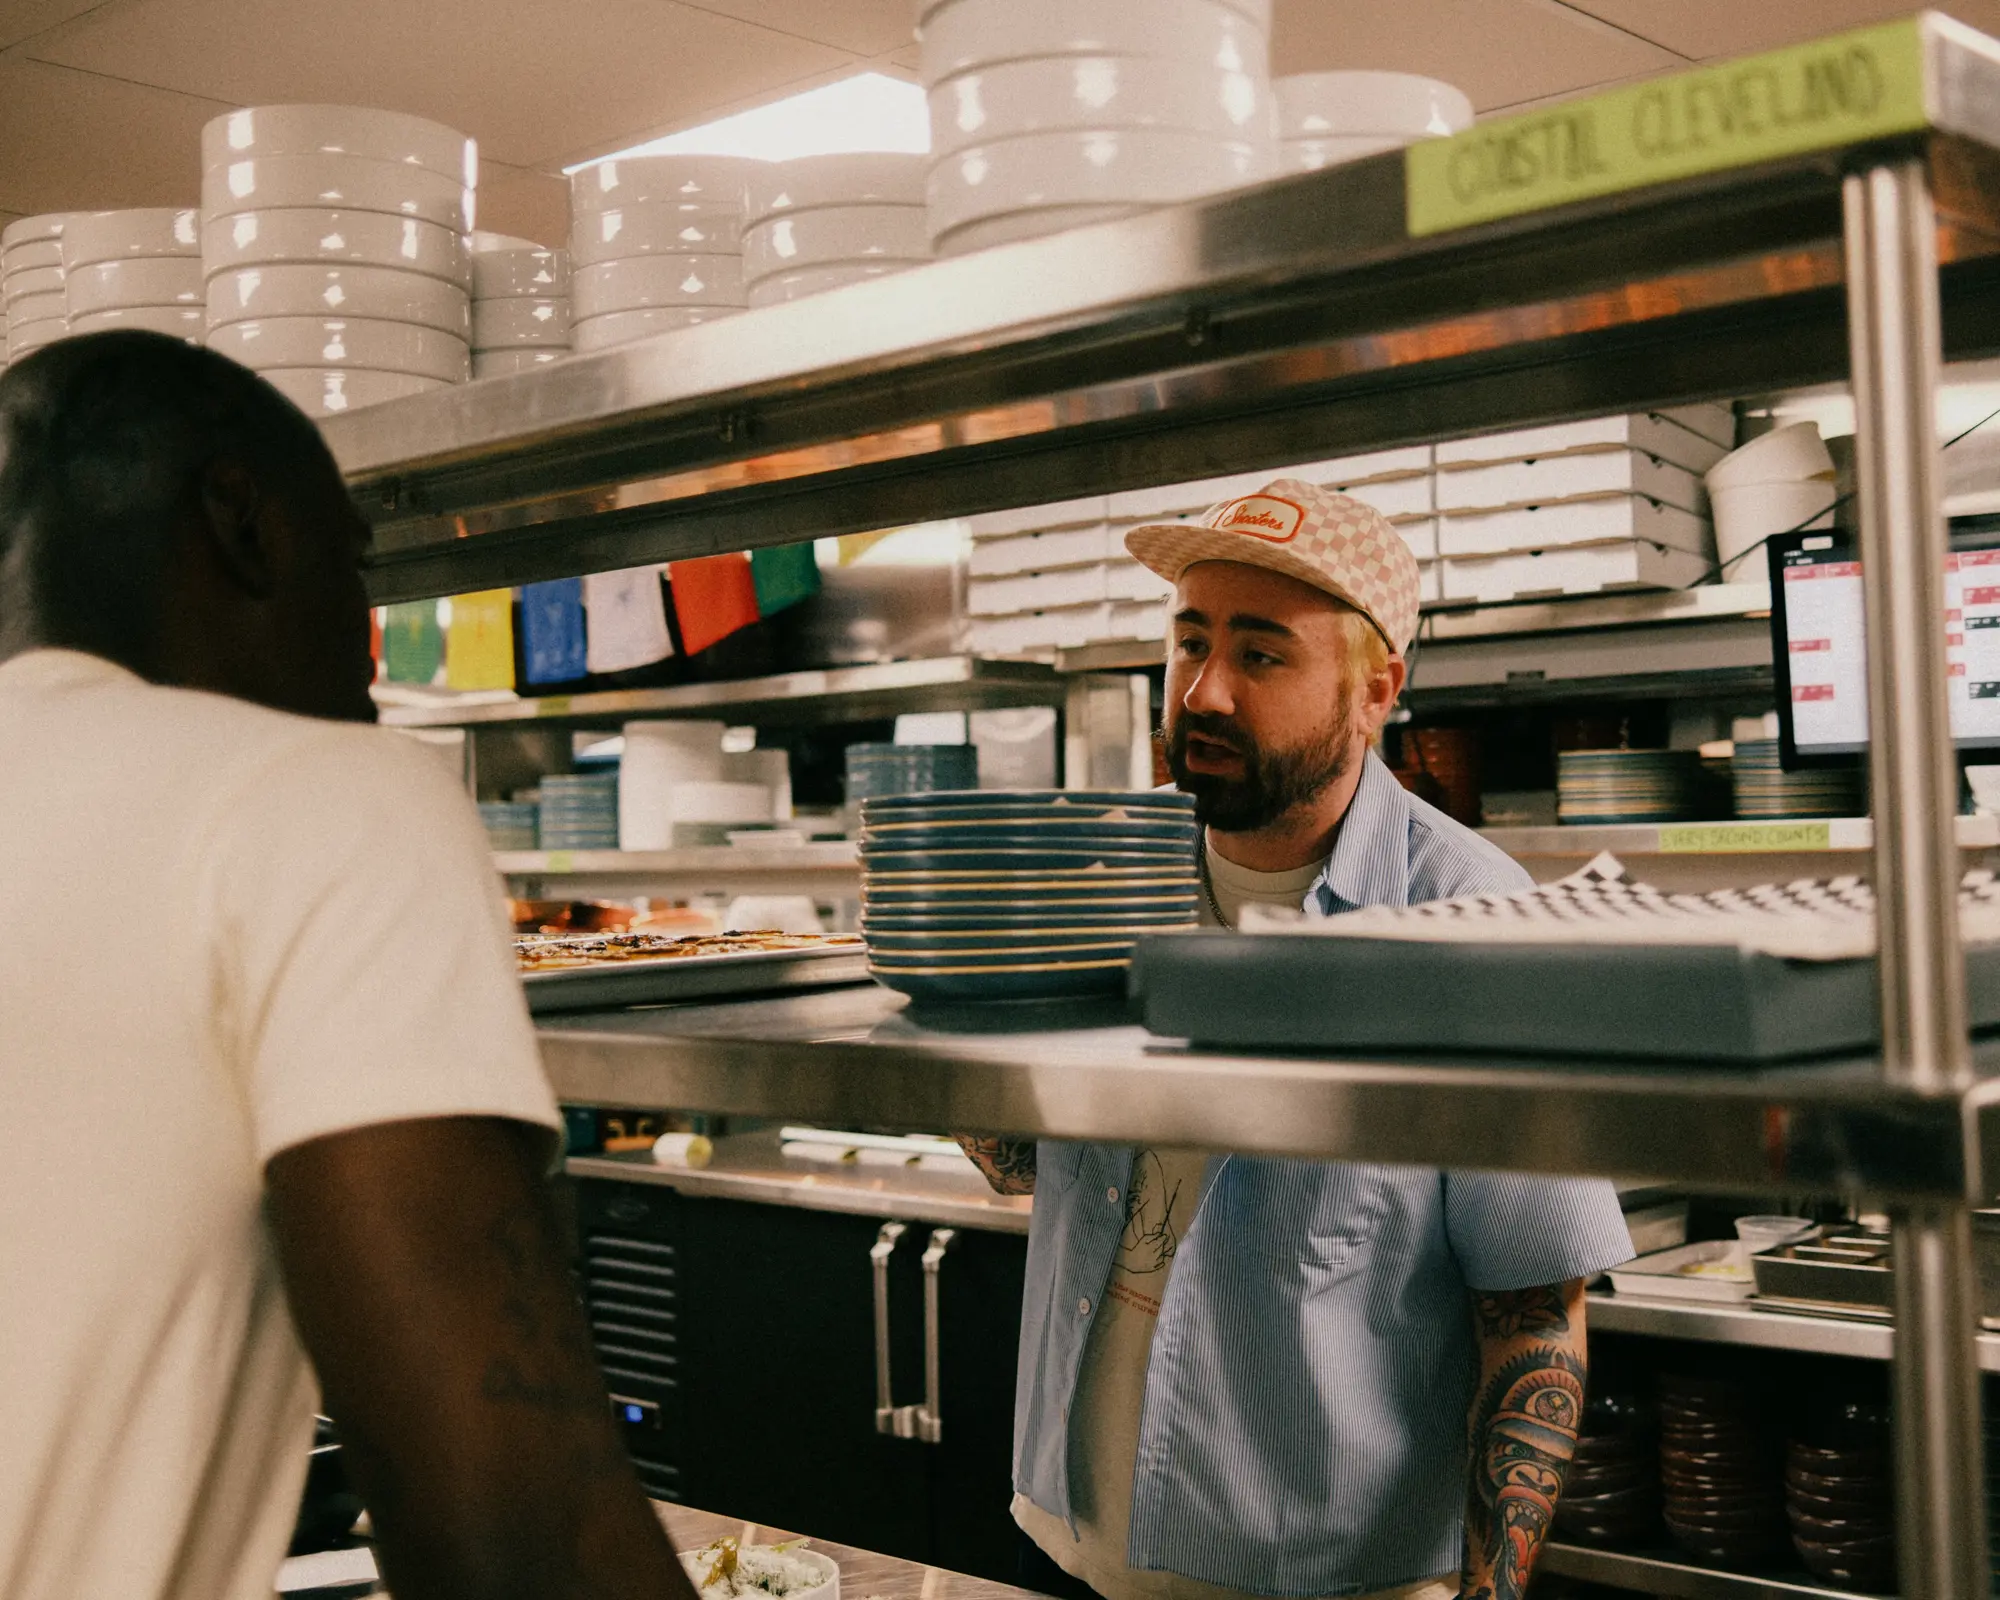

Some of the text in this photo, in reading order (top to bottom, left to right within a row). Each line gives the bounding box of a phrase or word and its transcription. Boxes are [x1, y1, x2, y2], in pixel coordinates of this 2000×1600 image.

[1631, 44, 1886, 158] CLEVELAND
[1709, 827, 1762, 845] SECOND
[1767, 825, 1825, 844] COUNTS
